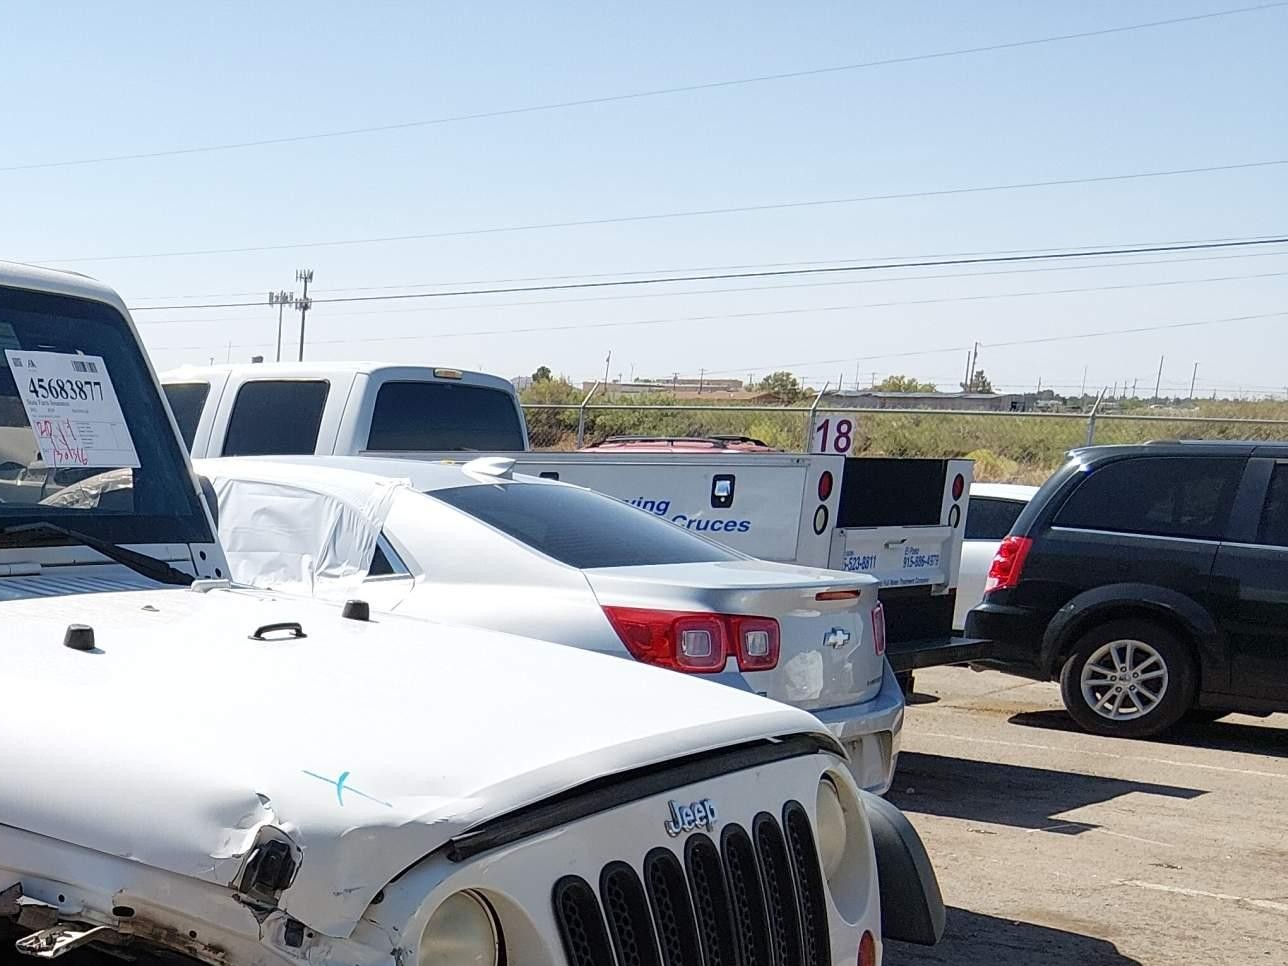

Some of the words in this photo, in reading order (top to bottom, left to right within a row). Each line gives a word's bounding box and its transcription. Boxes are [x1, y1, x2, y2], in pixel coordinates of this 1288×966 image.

[28, 377, 104, 401] 45683877
[816, 418, 852, 454] 18
[671, 514, 752, 533] Cruces
[664, 798, 720, 838] Jeep
